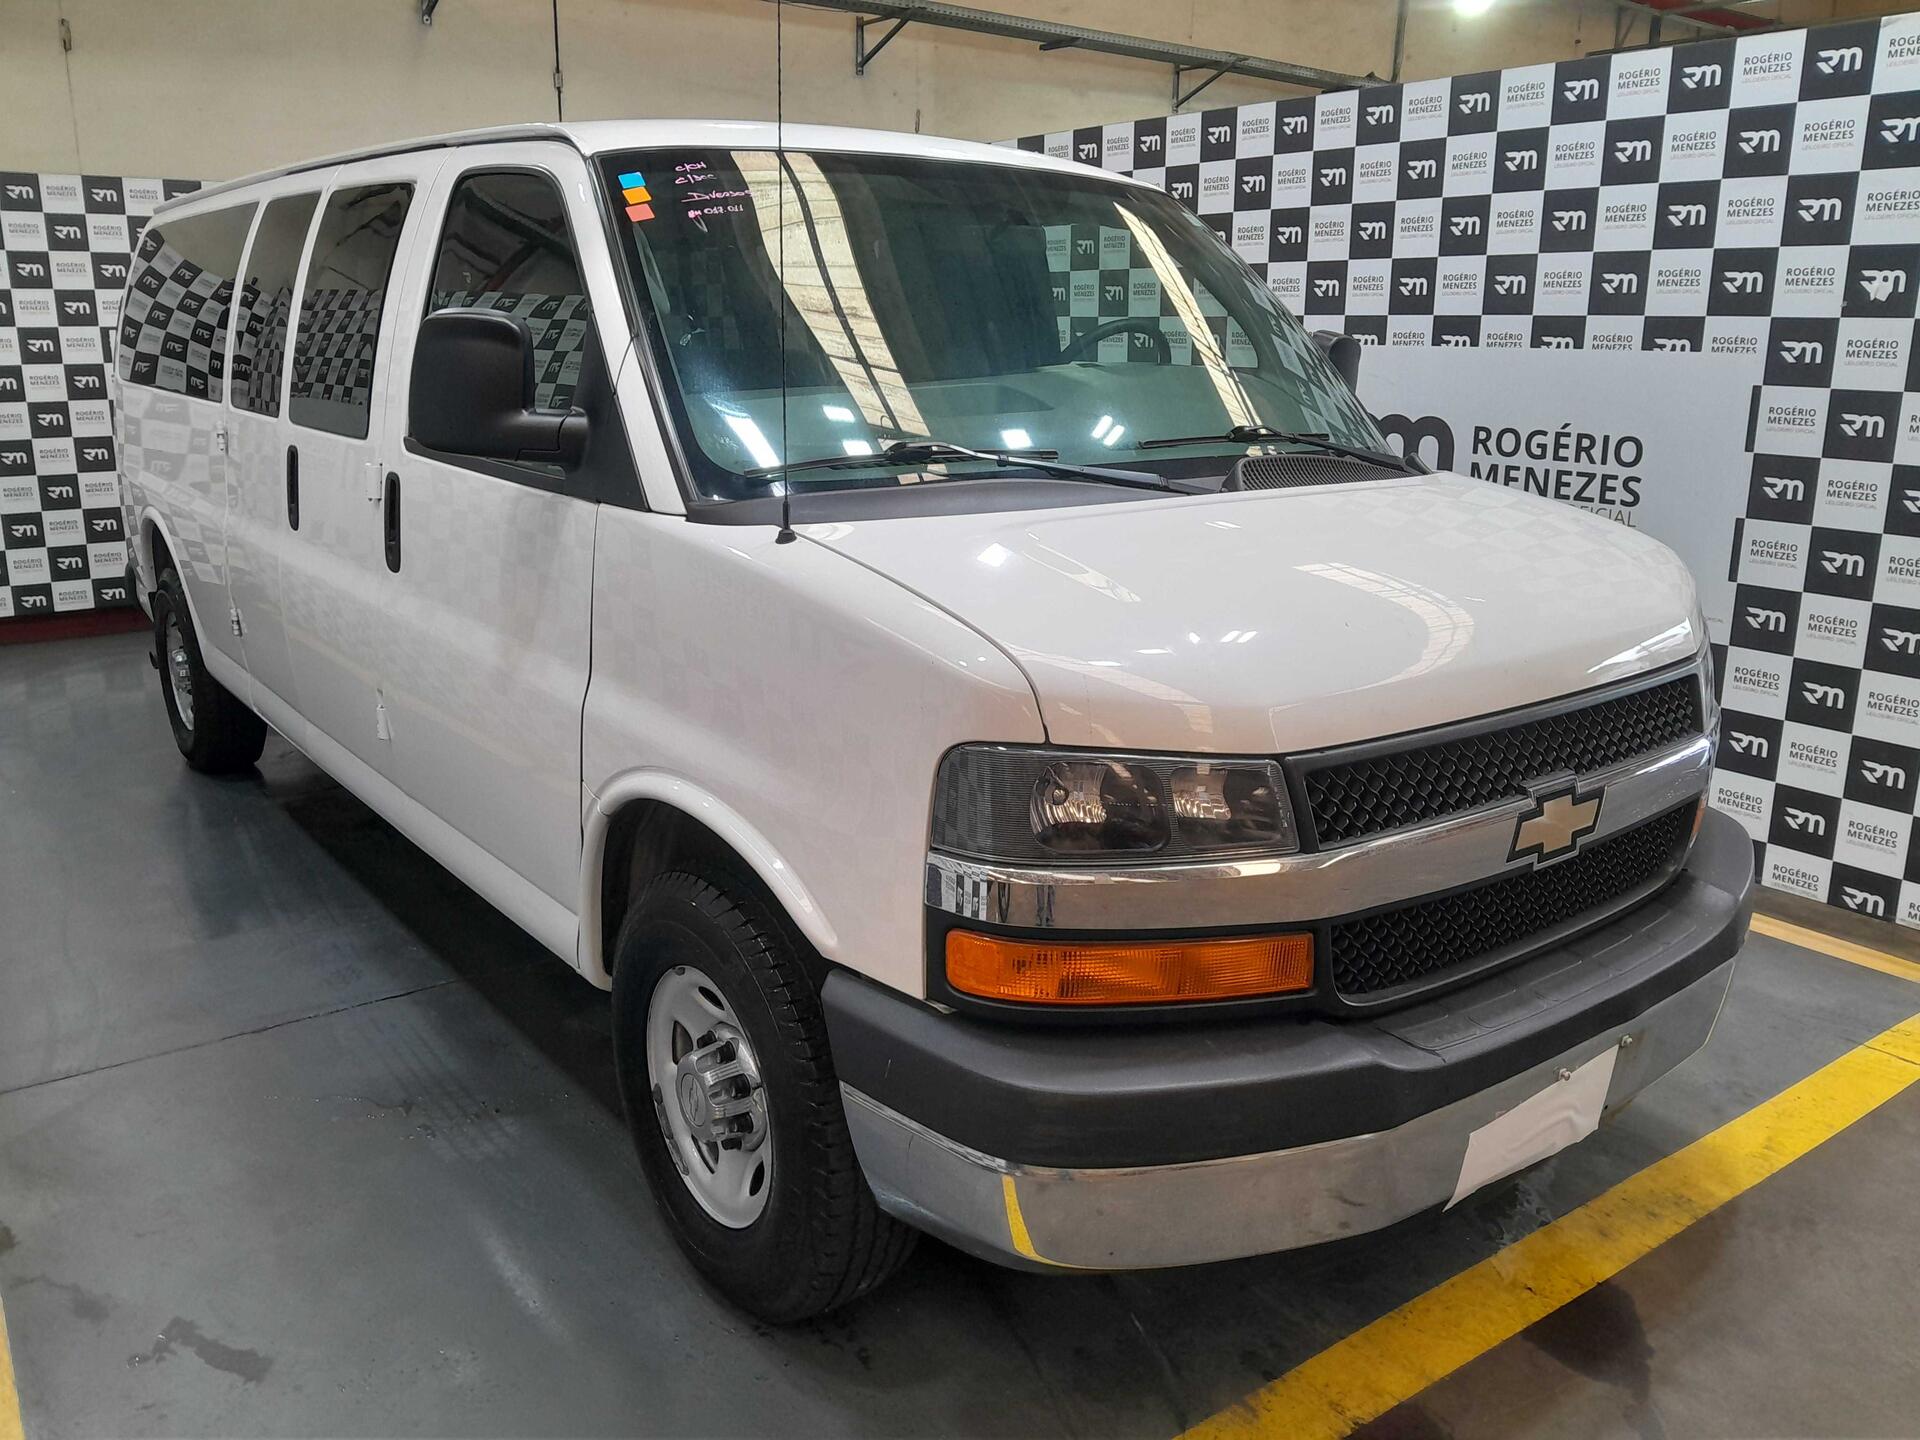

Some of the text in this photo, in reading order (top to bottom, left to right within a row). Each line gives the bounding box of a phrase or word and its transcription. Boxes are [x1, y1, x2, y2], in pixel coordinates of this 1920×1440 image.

[1744, 51, 1793, 66] ROGÉRIO
[1618, 67, 1661, 81] ROGÉRIO
[1743, 61, 1792, 77] MENEZES
[1507, 81, 1546, 94] ROGÉRIO
[1617, 76, 1661, 91] MENEZES
[1409, 95, 1443, 107] ROGÉRIO
[1507, 90, 1545, 103] MENEZES
[1321, 106, 1351, 118] ROGÉRIO
[1408, 103, 1443, 116] MENEZES
[1242, 117, 1270, 128] ROGÉRIO
[1320, 115, 1351, 126] MENEZES
[1804, 118, 1856, 132] ROGÉRIO
[1171, 127, 1196, 137] ROGÉRIO
[1672, 130, 1717, 143] ROGÉRIO
[1803, 129, 1855, 143] MENEZES
[1107, 135, 1129, 145] ROGÉRIO
[1555, 140, 1595, 153] ROGÉRIO
[1671, 140, 1717, 153] MENEZES
[1452, 150, 1488, 162] ROGÉRIO
[1555, 150, 1595, 162] MENEZES
[1360, 159, 1392, 170] ROGÉRIO
[1451, 160, 1487, 171] MENEZES
[1278, 167, 1306, 178] ROGÉRIO
[1360, 168, 1392, 179] MENEZES
[1204, 175, 1230, 184] ROGÉRIO
[1277, 176, 1306, 186] MENEZES
[1605, 202, 1647, 214] ROGÉRIO
[1728, 196, 1775, 208] ROGÉRIO
[1497, 208, 1534, 219] ROGÉRIO
[1605, 212, 1647, 224] MENEZES
[1726, 207, 1775, 219] MENEZES
[1315, 220, 1345, 229] ROGÉRIO
[1401, 214, 1434, 225] ROGÉRIO
[1496, 218, 1534, 228] MENEZES
[1238, 224, 1264, 234] ROGÉRIO
[1314, 228, 1344, 237] MENEZES
[1400, 224, 1434, 233] MENEZES
[1443, 272, 1478, 281] ROGÉRIO
[1544, 269, 1583, 280] ROGÉRIO
[1657, 267, 1702, 278] ROGÉRIO
[1786, 265, 1836, 277] ROGÉRIO
[1272, 276, 1300, 285] ROGÉRIO
[1353, 274, 1384, 283] ROGÉRIO
[1543, 279, 1582, 289] MENEZES
[1656, 278, 1701, 288] MENEZES
[1784, 277, 1835, 287] MENEZES
[1272, 285, 1300, 293] MENEZES
[1352, 283, 1384, 291] MENEZES
[1442, 281, 1477, 290] MENEZES
[1393, 330, 1425, 339] ROGÉRIO
[1487, 331, 1523, 341] ROGÉRIO
[1592, 332, 1633, 343] ROGÉRIO
[1712, 334, 1758, 346] ROGÉRIO
[1847, 337, 1900, 349] ROGÉRIO
[1845, 349, 1899, 360] MENEZES
[1768, 405, 1817, 417] ROGÉRIO
[1767, 415, 1816, 427] MENEZES
[1472, 423, 1643, 468] ROGÉRIO
[1827, 479, 1879, 492] ROGÉRIO
[1826, 489, 1878, 503] MENEZES
[1751, 539, 1799, 553] ROGÉRIO
[1750, 548, 1798, 562] MENEZES
[1808, 613, 1858, 629] ROGÉRIO
[1807, 622, 1858, 639] MENEZES
[1734, 666, 1781, 682] ROGÉRIO
[1733, 674, 1780, 691] MENEZES
[1790, 741, 1839, 759] ROGÉRIO
[1789, 750, 1838, 769] MENEZES
[1718, 787, 1763, 805] ROGÉRIO
[1717, 795, 1763, 815] MENEZES
[1848, 819, 1899, 840] ROGÉRIO
[1847, 828, 1898, 849] MENEZES
[1773, 863, 1820, 883] ROGÉRIO
[1771, 871, 1819, 893] MENEZES
